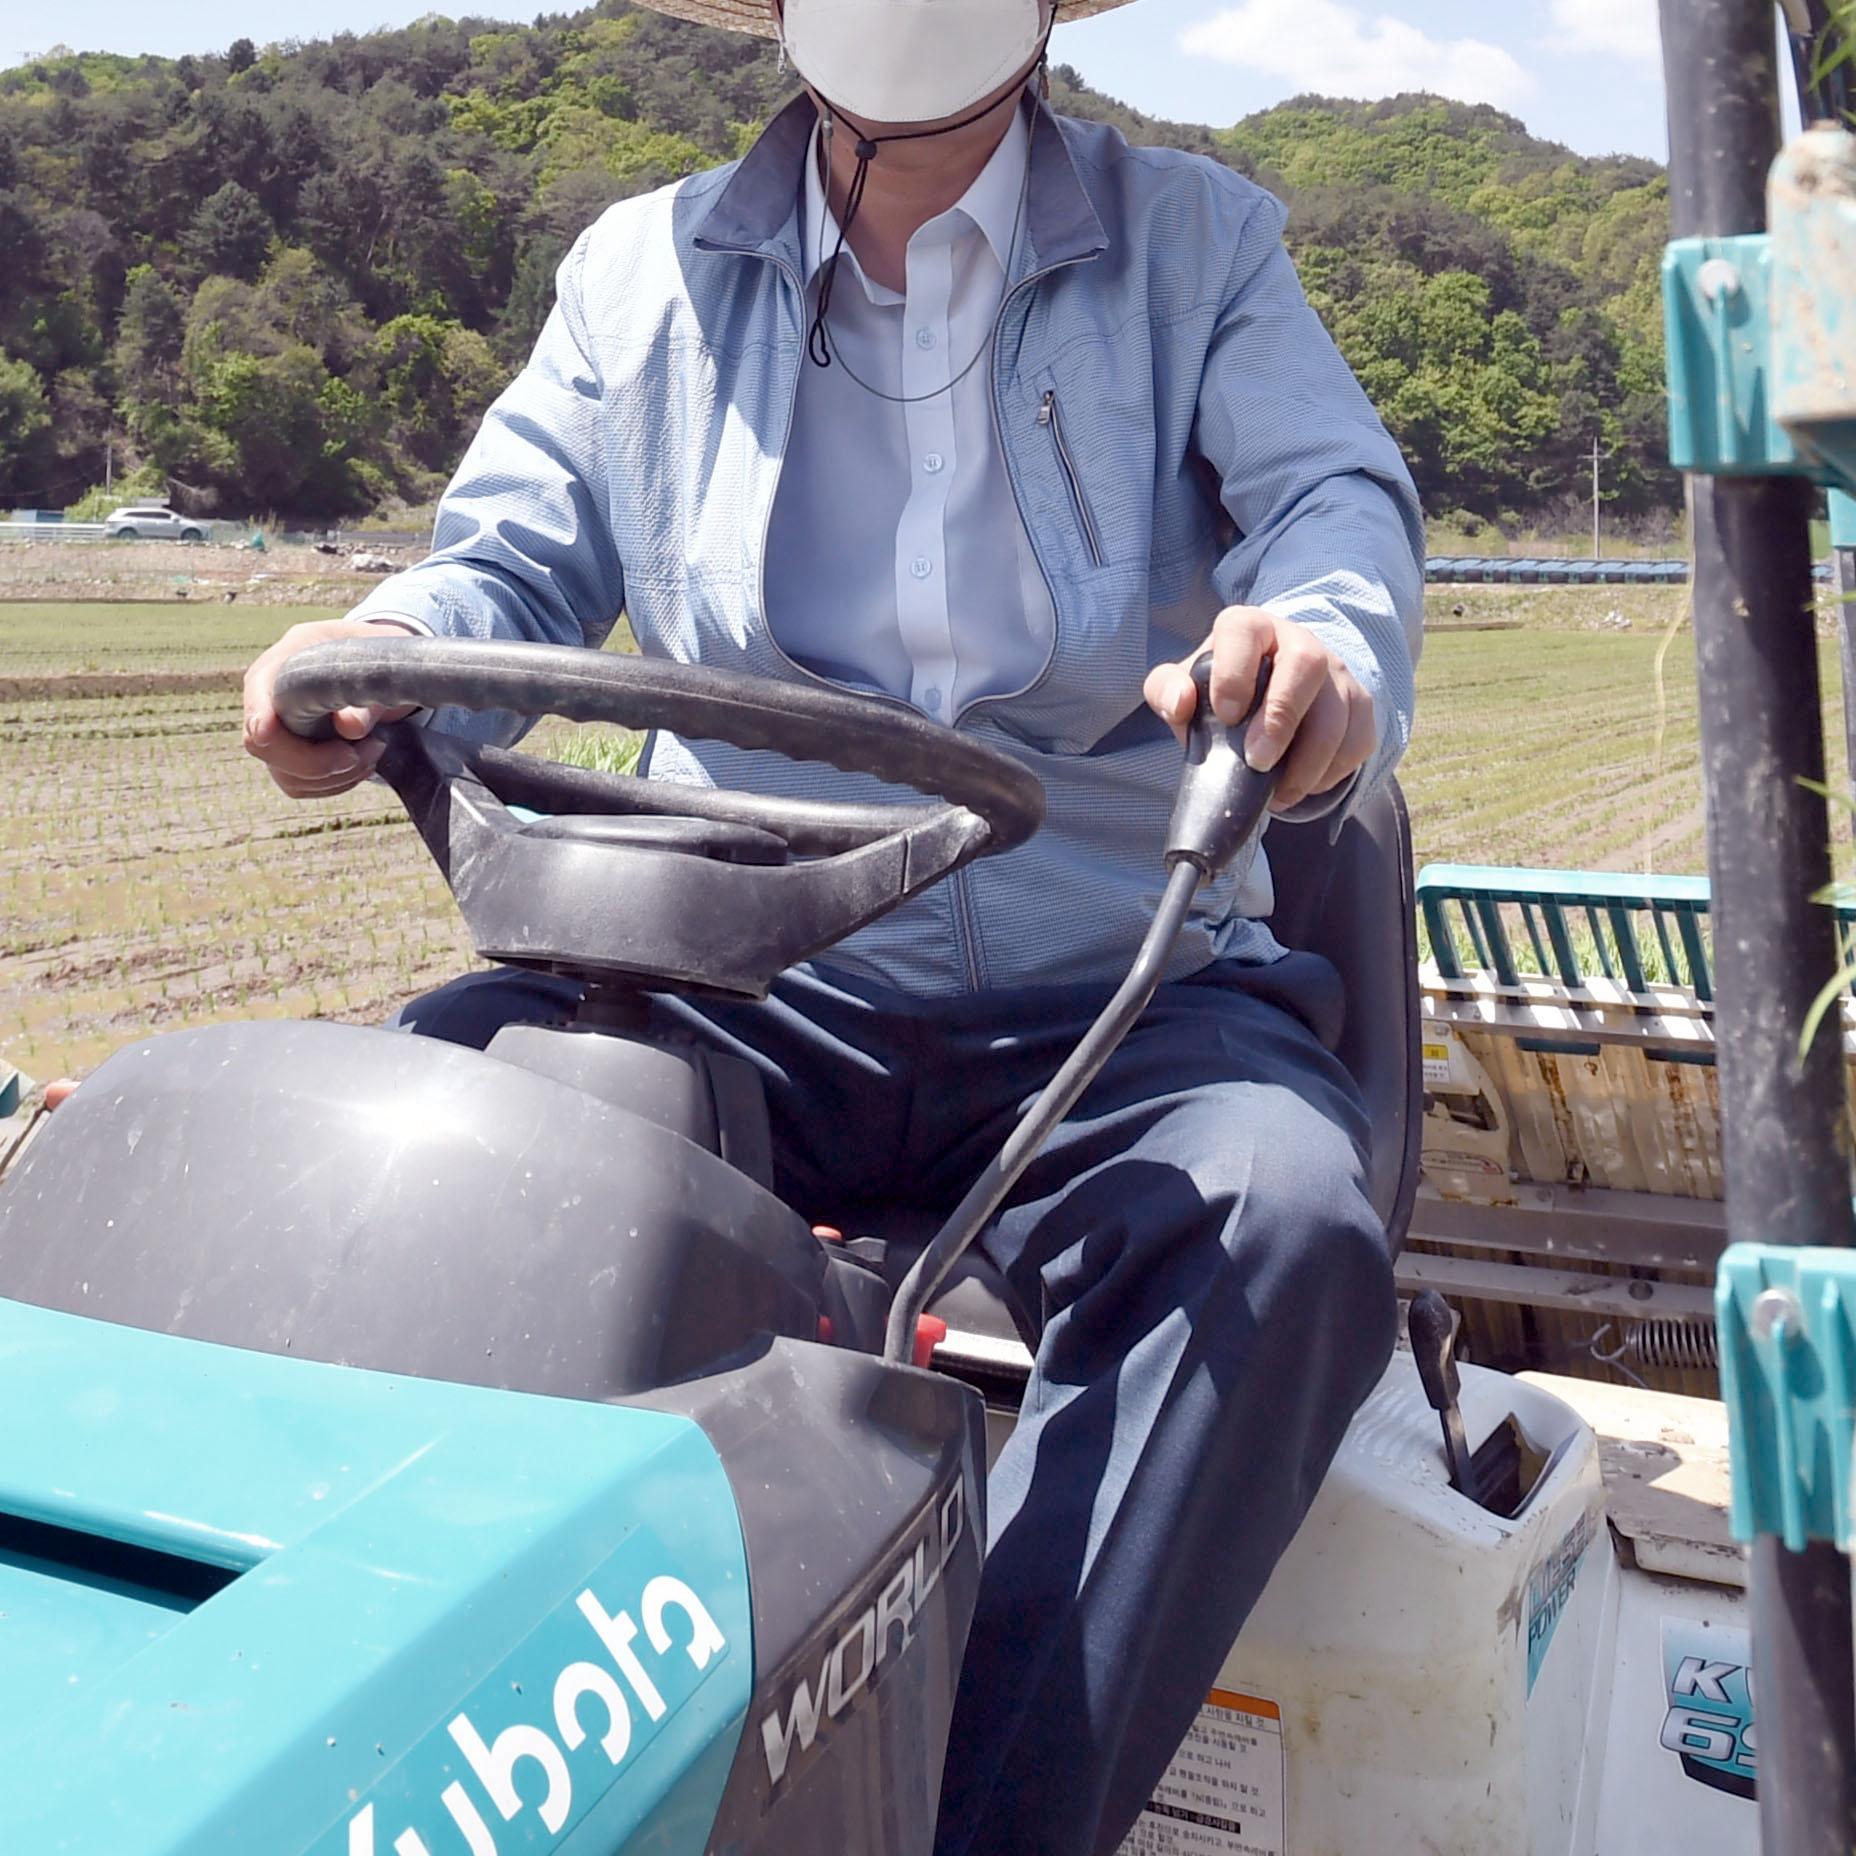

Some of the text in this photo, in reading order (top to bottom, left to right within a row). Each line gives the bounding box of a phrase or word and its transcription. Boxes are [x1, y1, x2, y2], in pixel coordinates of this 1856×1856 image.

[761, 1472, 964, 1786] WORLD
[1528, 1571, 1576, 1655] POWER
[1672, 1655, 1756, 1710] K
[348, 1574, 727, 1856] ubota
